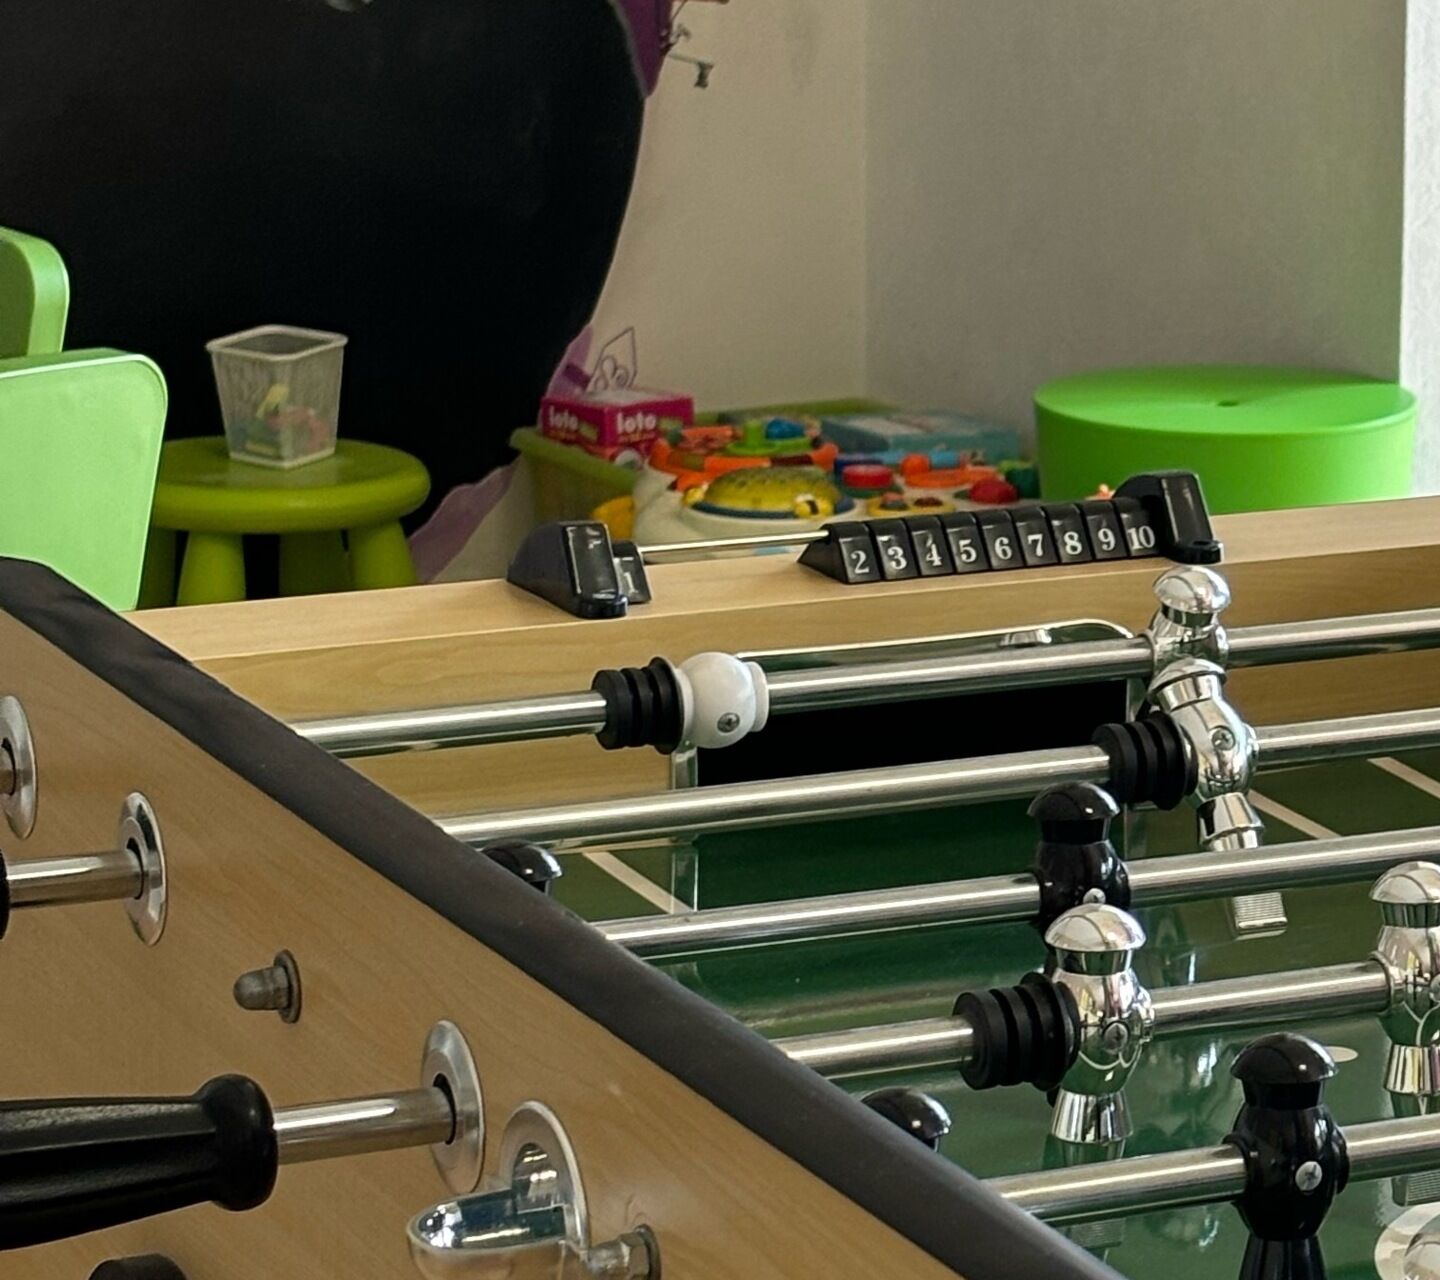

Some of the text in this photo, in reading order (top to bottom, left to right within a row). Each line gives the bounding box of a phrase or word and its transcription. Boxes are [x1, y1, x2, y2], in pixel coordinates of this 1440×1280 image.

[549, 405, 580, 432] loto
[616, 412, 657, 435] loto
[623, 525, 1156, 593] 1 2 3 4 5 6 7 8 9 10
